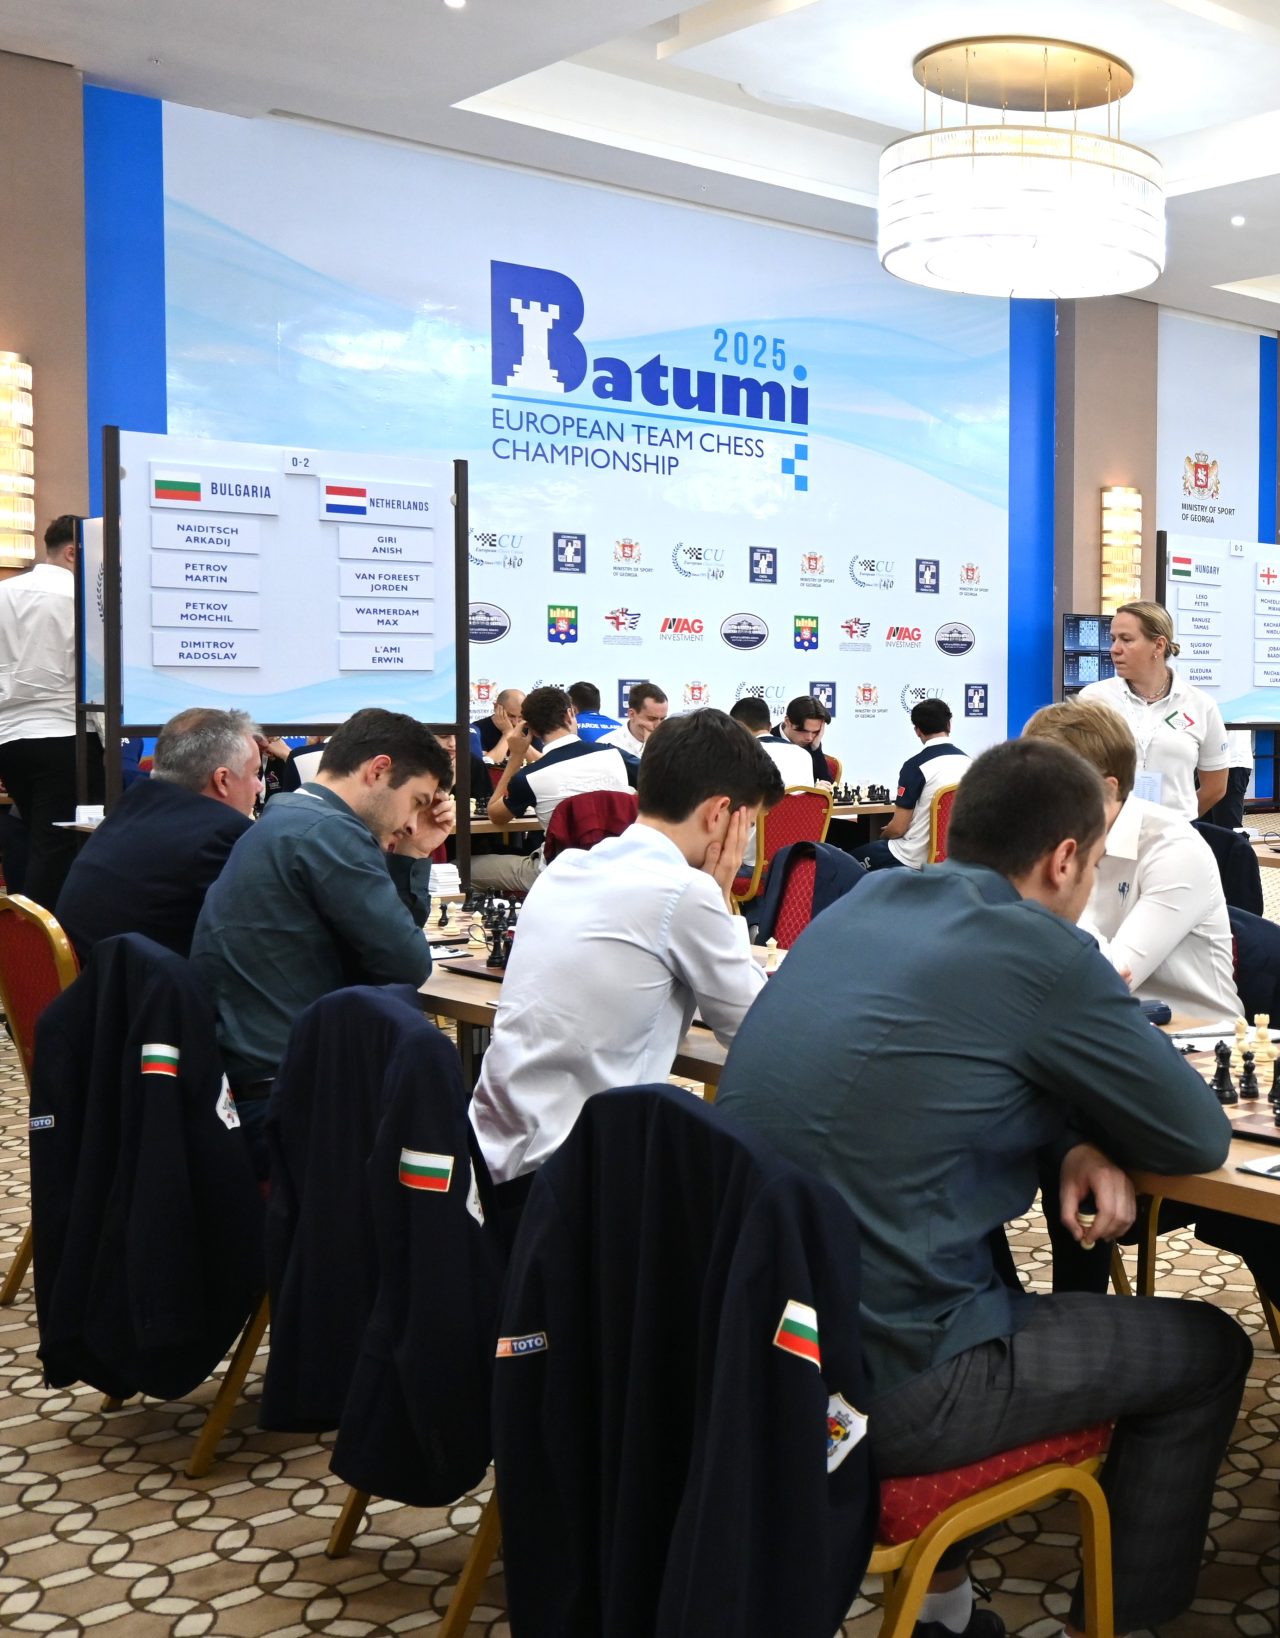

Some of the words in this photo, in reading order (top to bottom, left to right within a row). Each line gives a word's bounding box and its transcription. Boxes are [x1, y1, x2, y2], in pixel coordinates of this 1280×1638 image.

[490, 259, 809, 425] Batumi
[714, 328, 786, 371] 2025
[492, 408, 624, 442] EUROPEAN
[632, 423, 693, 451] TEAM
[700, 433, 765, 458] CHESS
[492, 438, 680, 476] CHAMPIONSHIP
[291, 457, 310, 468] 0-2
[211, 481, 271, 499] BULGARIA
[369, 497, 429, 512] NETHERLANDS
[1181, 503, 1207, 513] MINISTRY
[1208, 506, 1216, 514] OF
[1217, 507, 1235, 515] SPORT
[1181, 513, 1189, 521] OF
[1190, 514, 1215, 524] GEORGIA
[177, 524, 239, 535] NAIDITSCH
[185, 536, 231, 547] ARKADIJ
[377, 536, 397, 544] GIRI
[474, 533, 523, 548] ECU
[372, 546, 402, 555] ANISH
[683, 548, 725, 561] ECU
[185, 563, 228, 572] PETROV
[1195, 564, 1220, 575] HUNGARY
[185, 574, 228, 583] MARTIN
[355, 573, 374, 581] VAN
[376, 573, 420, 583] FOREEST
[370, 583, 408, 592] JORDEN
[185, 602, 228, 611] PETKOV
[355, 607, 419, 617] WARMERDAM
[180, 613, 233, 622] MOMCHIL
[377, 618, 399, 626] MAX
[660, 634, 703, 642] INVESTMENT
[181, 641, 235, 649] DIMITROV
[375, 645, 400, 654] L'AMI
[178, 652, 237, 660] RADOSLAV
[372, 656, 403, 664] ERWIN
